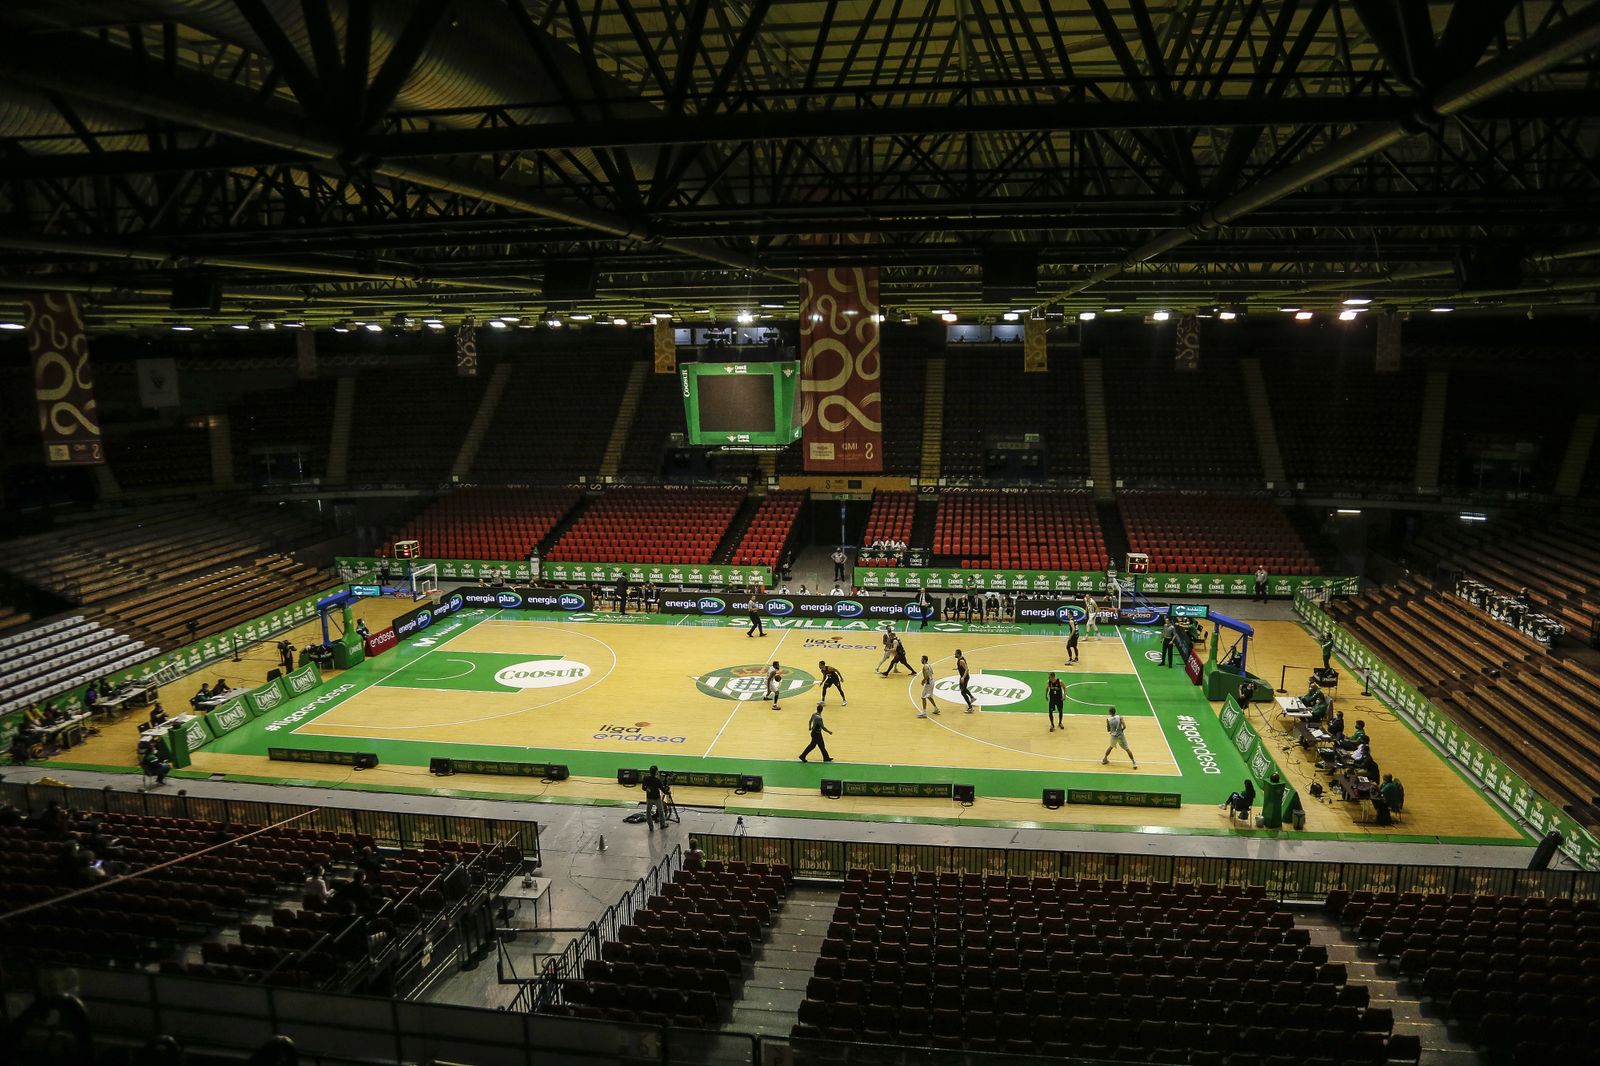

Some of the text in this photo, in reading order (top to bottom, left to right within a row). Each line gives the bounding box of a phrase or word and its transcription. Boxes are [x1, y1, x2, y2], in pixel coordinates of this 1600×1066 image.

[498, 595, 515, 604] plus
[561, 596, 578, 606] plus
[700, 600, 718, 610] plus
[768, 602, 786, 612] plus
[838, 604, 856, 614] plus
[908, 604, 920, 615] plu
[370, 629, 395, 648] endesa
[499, 668, 584, 680] COOSUR
[264, 684, 356, 731] #ligaendesa
[599, 724, 642, 734] liga
[593, 733, 686, 744] endesa
[1176, 714, 1221, 774] #ligaendesa
